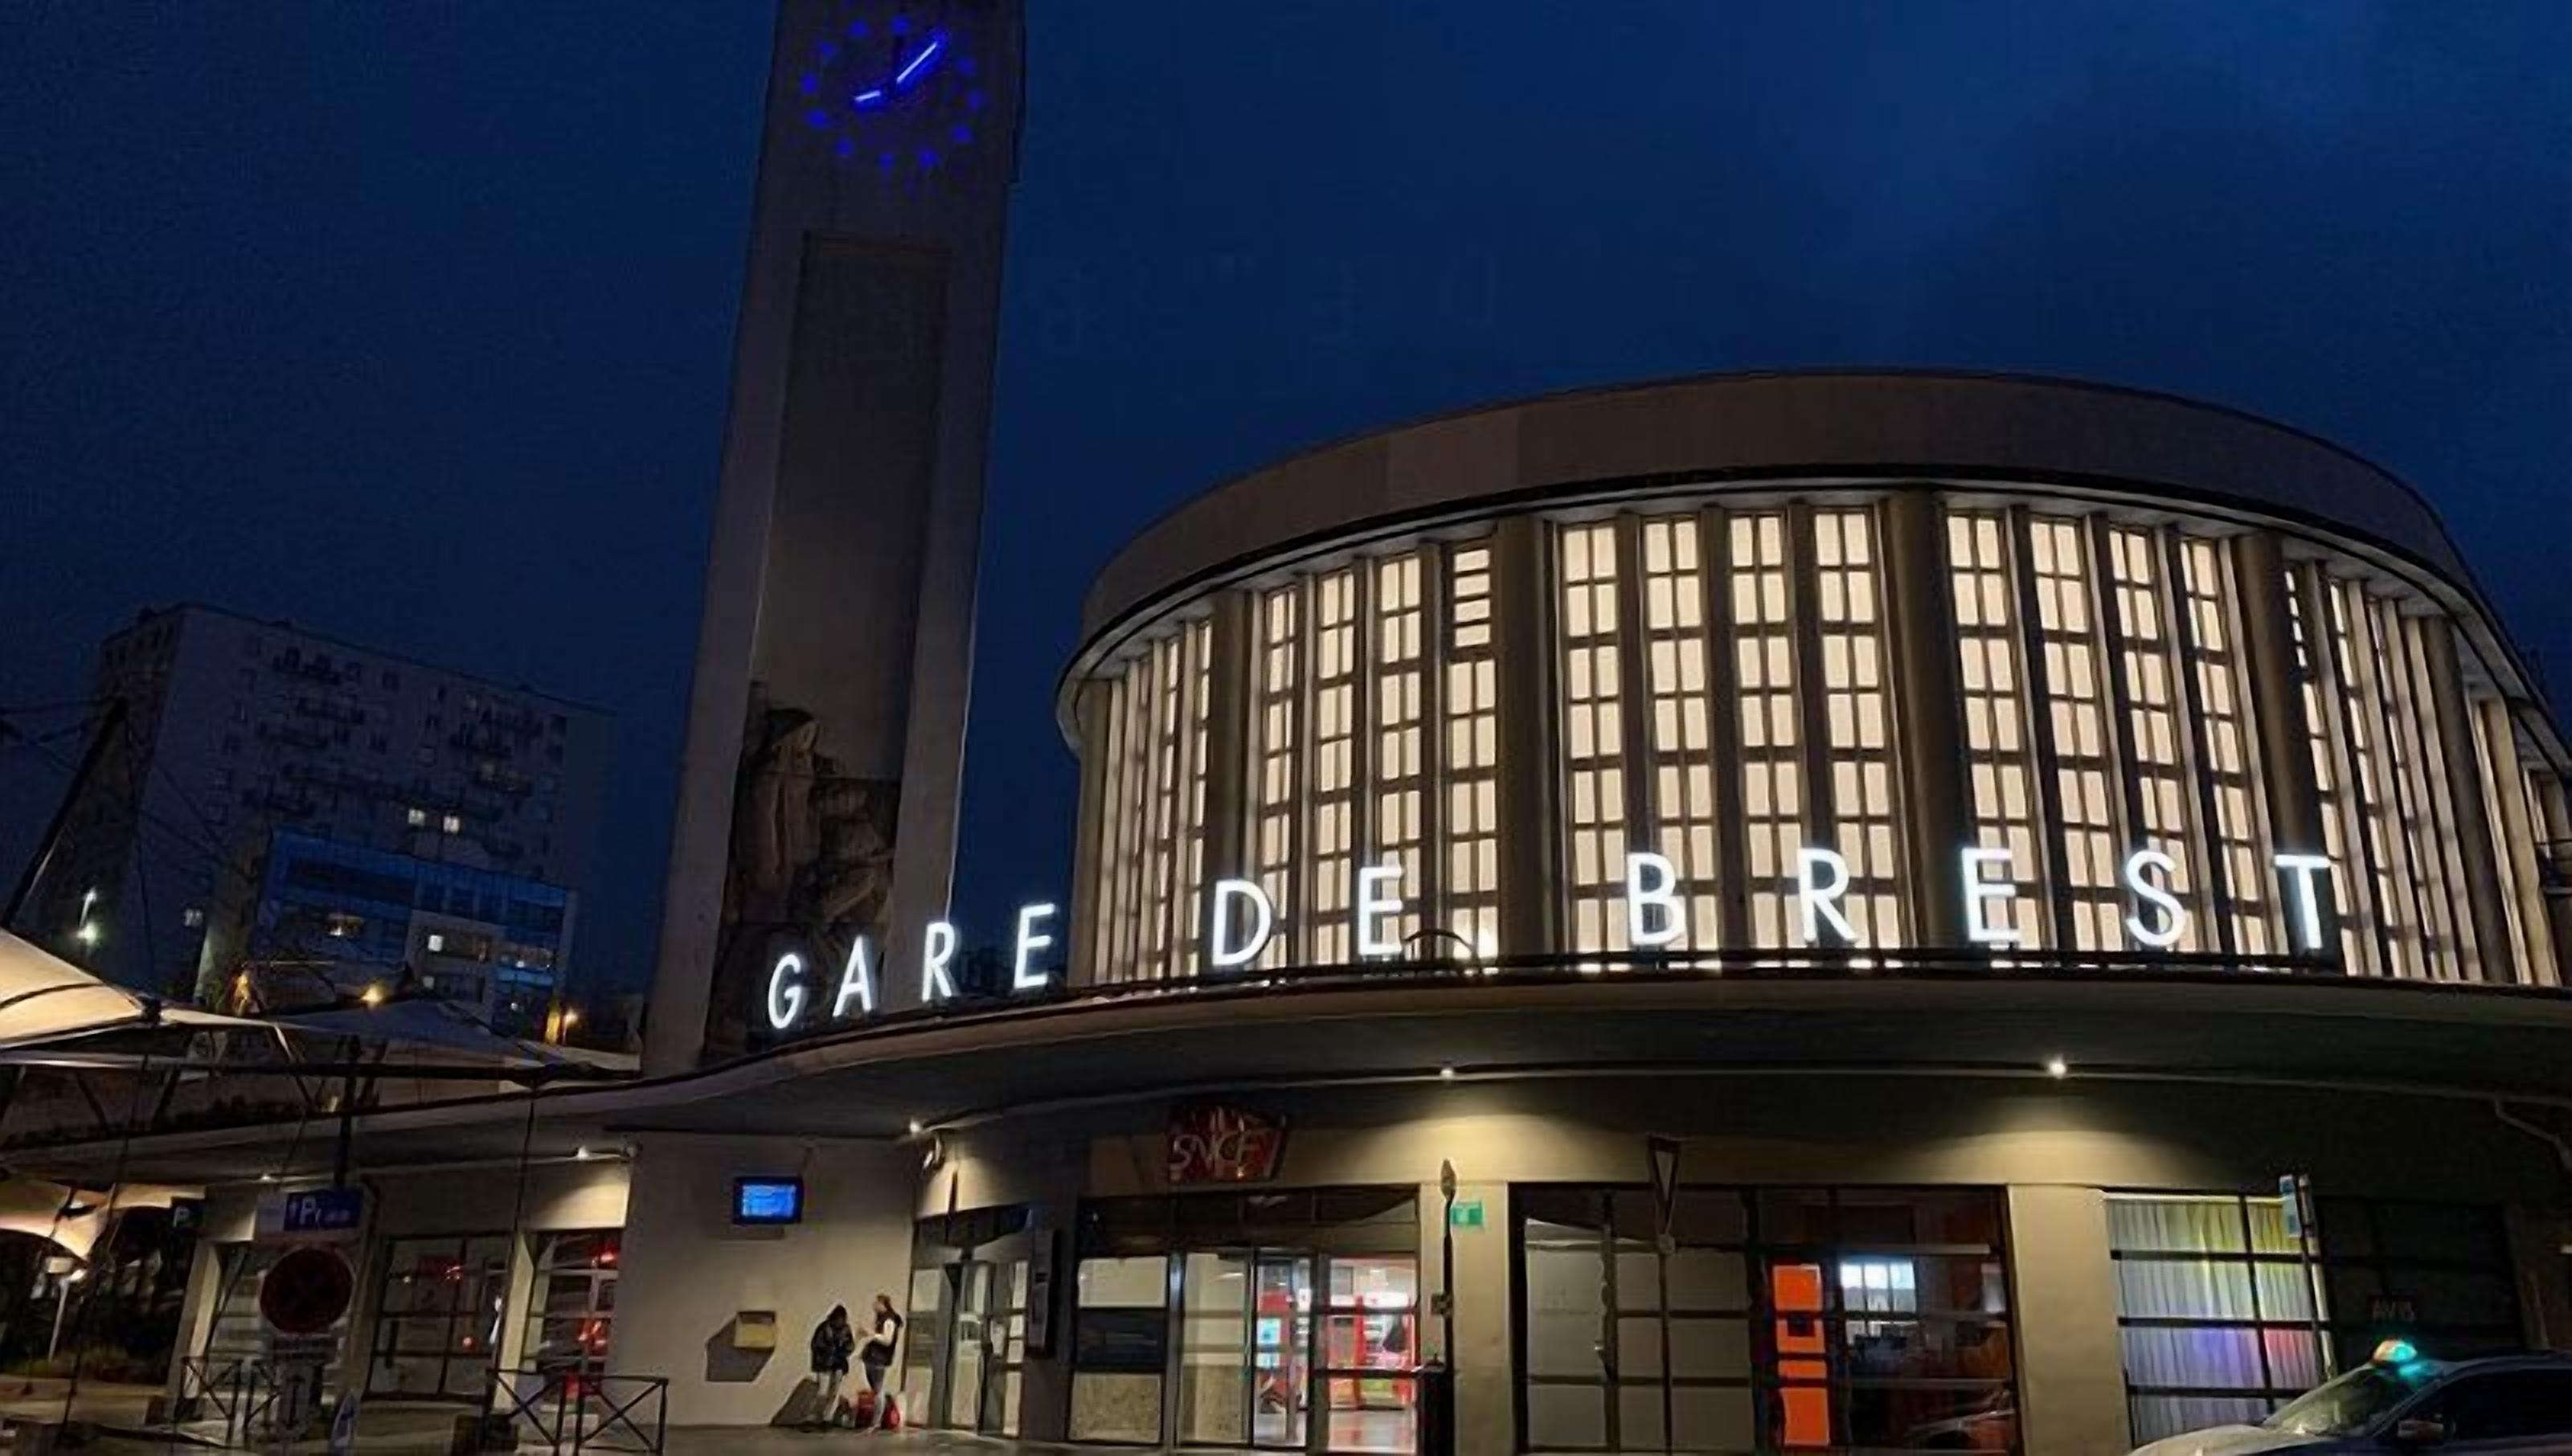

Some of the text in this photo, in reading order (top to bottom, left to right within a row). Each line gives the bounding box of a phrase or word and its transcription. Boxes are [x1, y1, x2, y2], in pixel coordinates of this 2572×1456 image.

[767, 848, 2332, 1029] GARE DE BREST
[1169, 1131, 1275, 1181] SNCF
